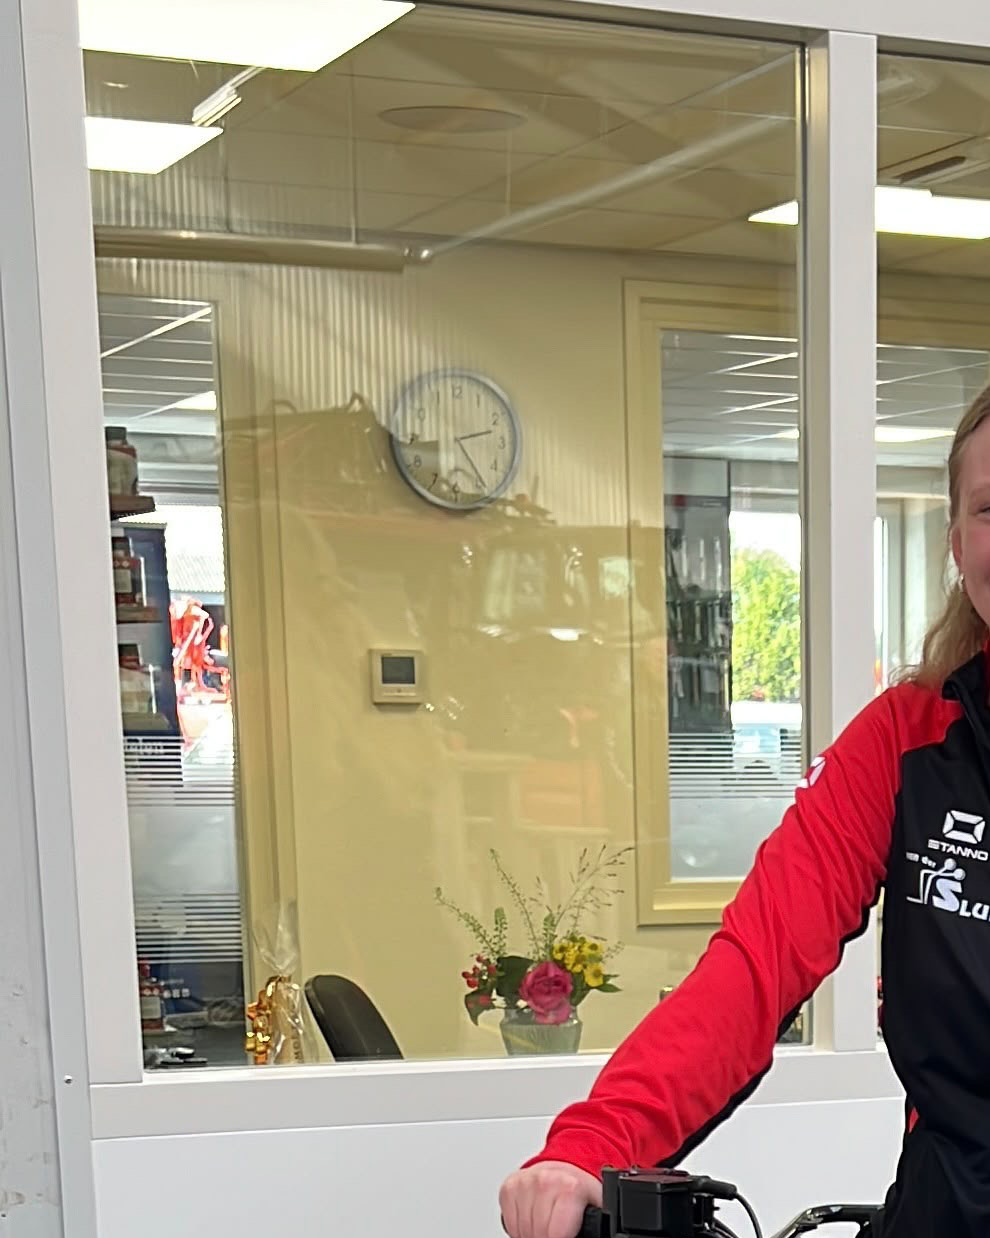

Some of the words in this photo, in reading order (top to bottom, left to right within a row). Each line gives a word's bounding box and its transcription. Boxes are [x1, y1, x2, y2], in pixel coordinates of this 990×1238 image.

[491, 411, 500, 427] 2
[498, 435, 506, 450] 3
[489, 459, 498, 472] 4
